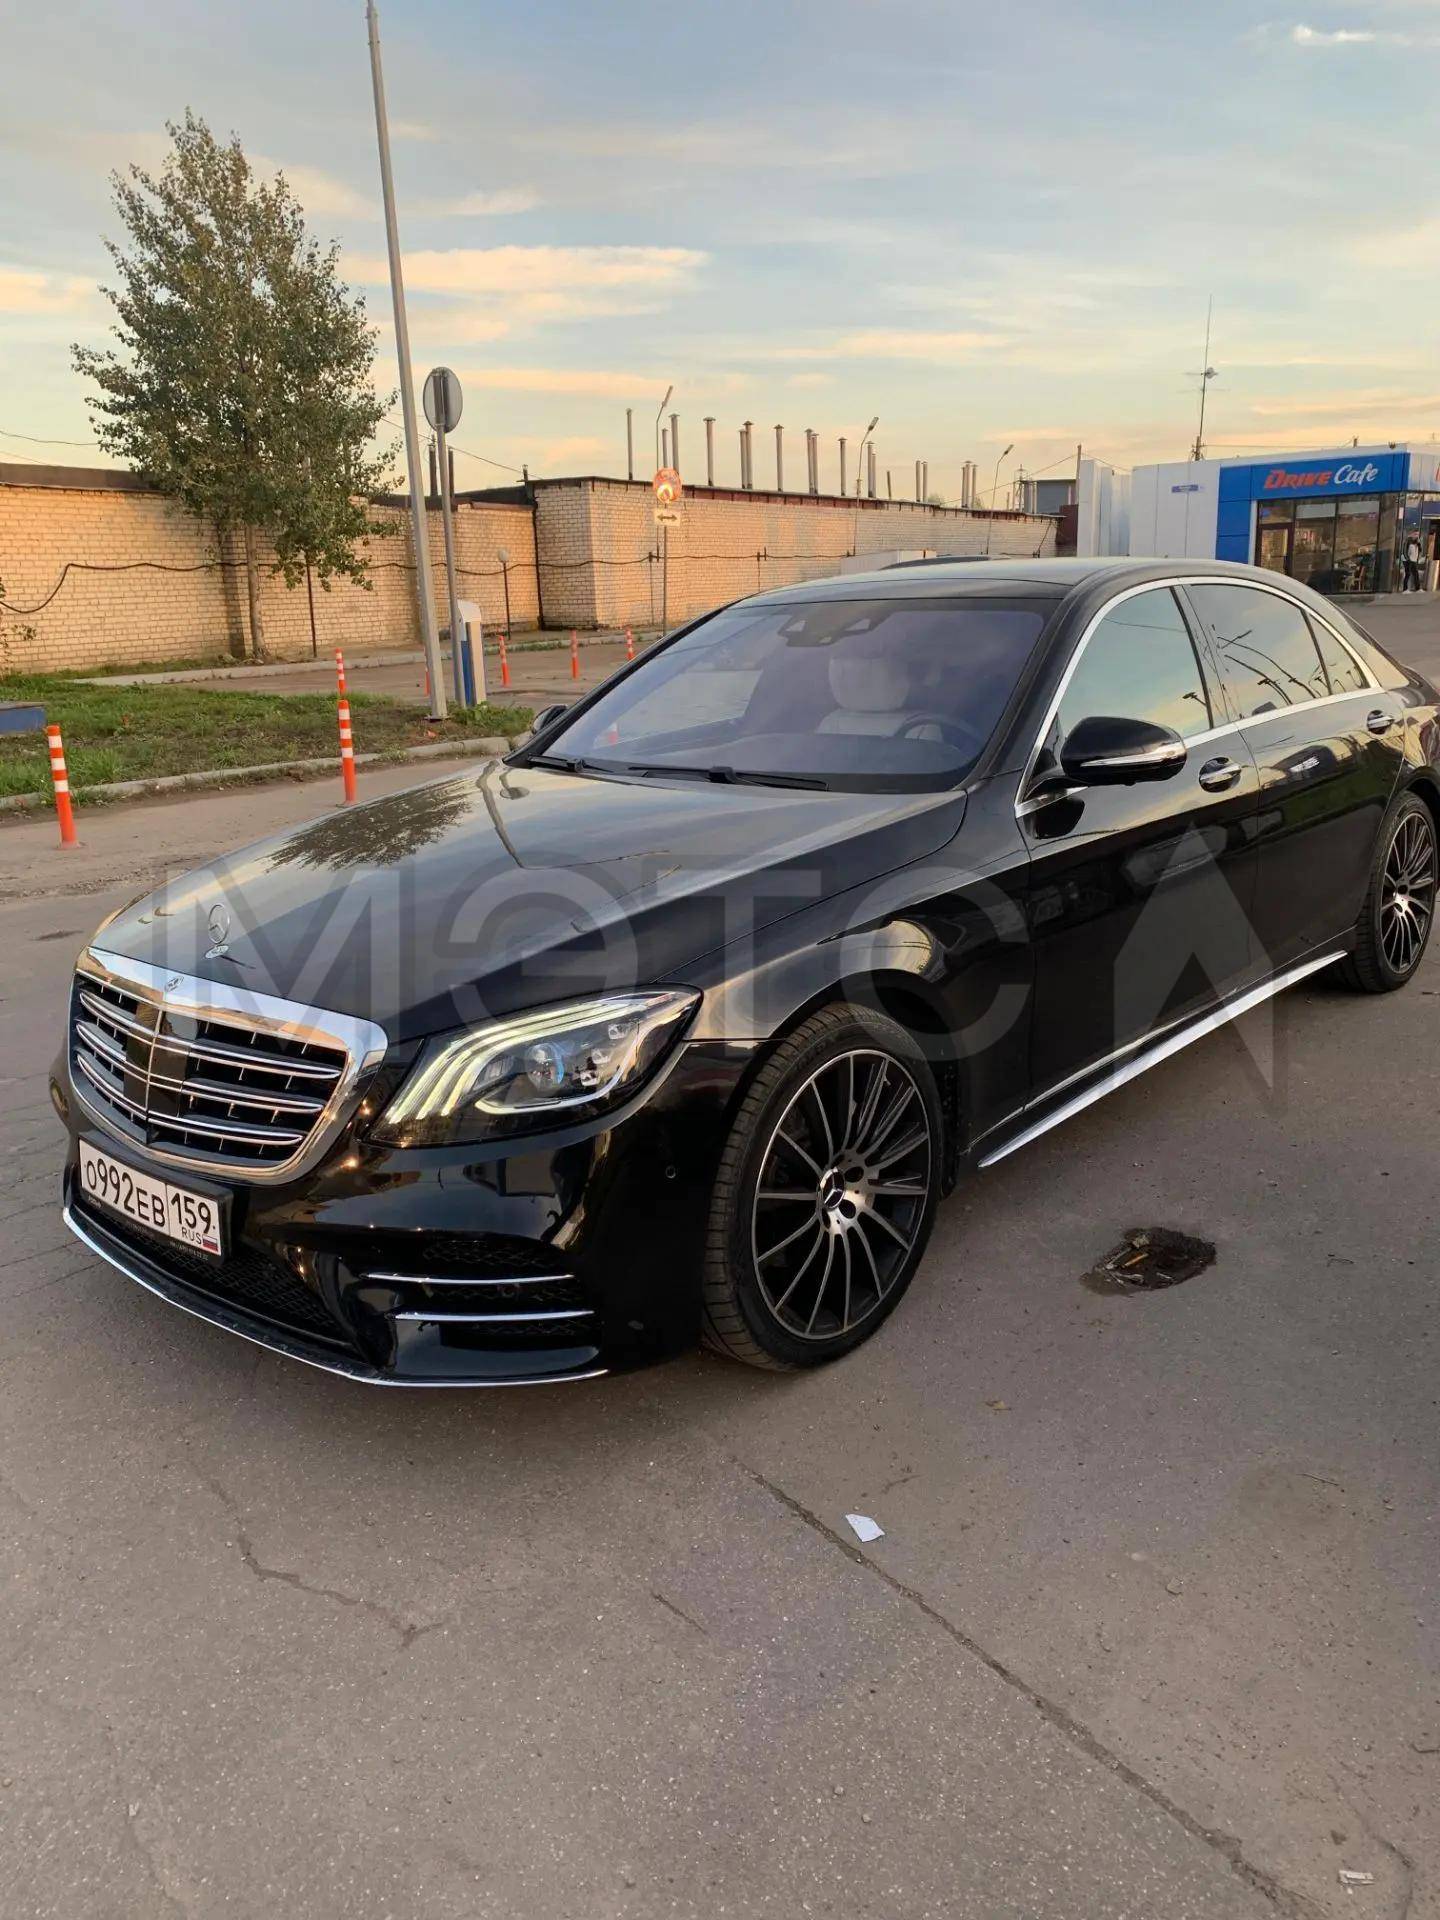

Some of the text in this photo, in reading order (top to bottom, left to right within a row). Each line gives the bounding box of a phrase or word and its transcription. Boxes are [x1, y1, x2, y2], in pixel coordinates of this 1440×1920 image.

[1334, 463, 1378, 486] Cafe
[171, 1192, 212, 1234] 159
[181, 1227, 202, 1245] RUS
